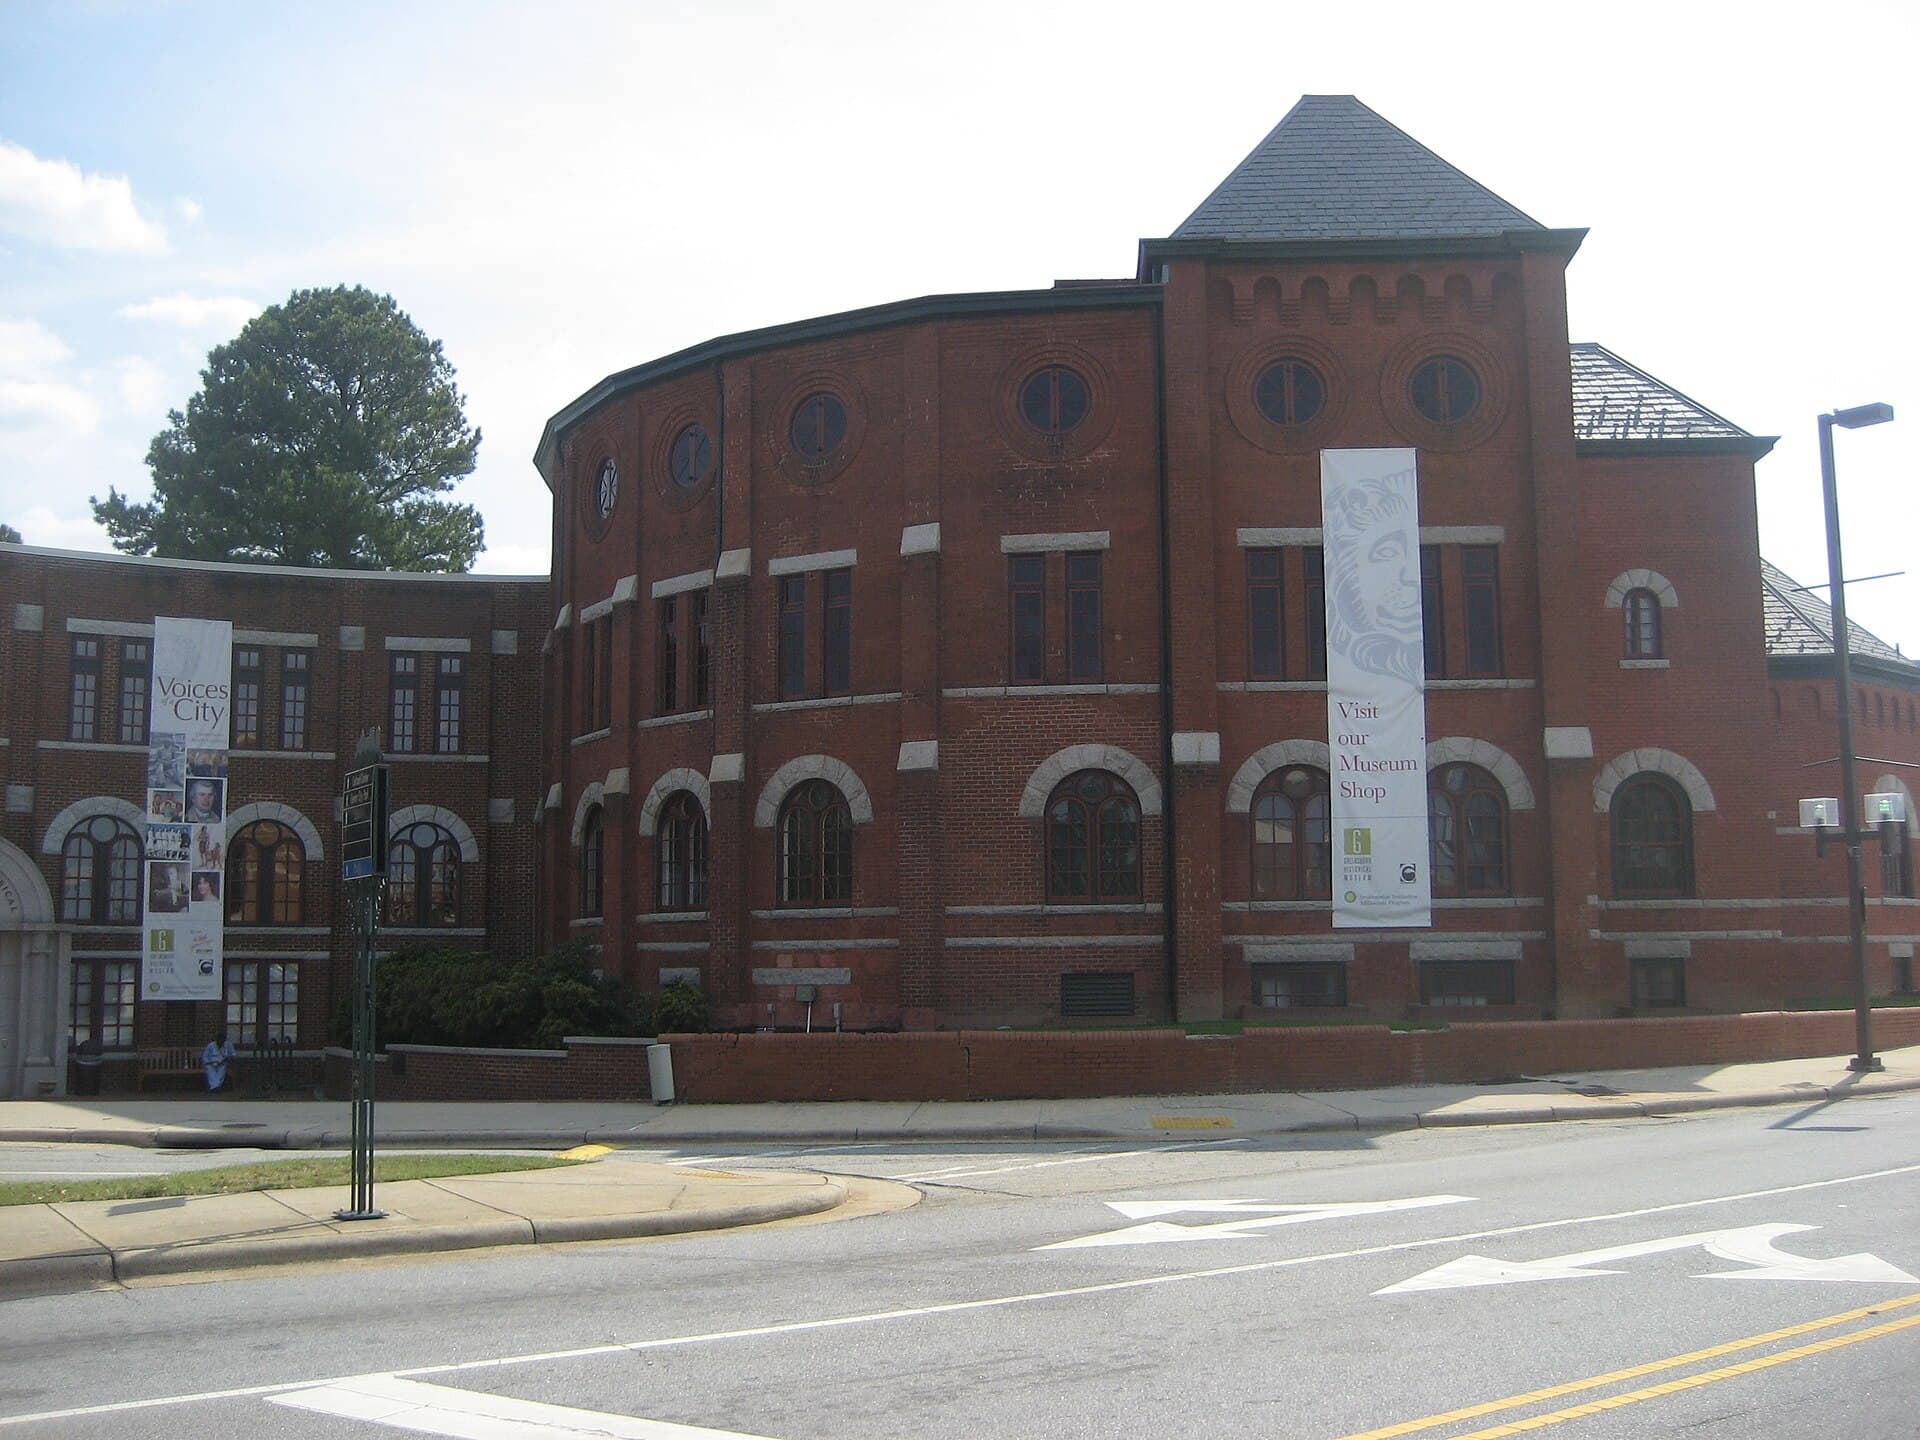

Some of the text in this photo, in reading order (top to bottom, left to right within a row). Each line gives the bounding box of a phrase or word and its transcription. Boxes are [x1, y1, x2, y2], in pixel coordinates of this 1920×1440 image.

[158, 676, 228, 699] Voices
[174, 698, 224, 729] City
[1338, 702, 1379, 718] Visit
[1338, 733, 1369, 746] our
[1340, 755, 1417, 772] Museum
[1340, 780, 1387, 804] Shop
[1353, 829, 1361, 854] G
